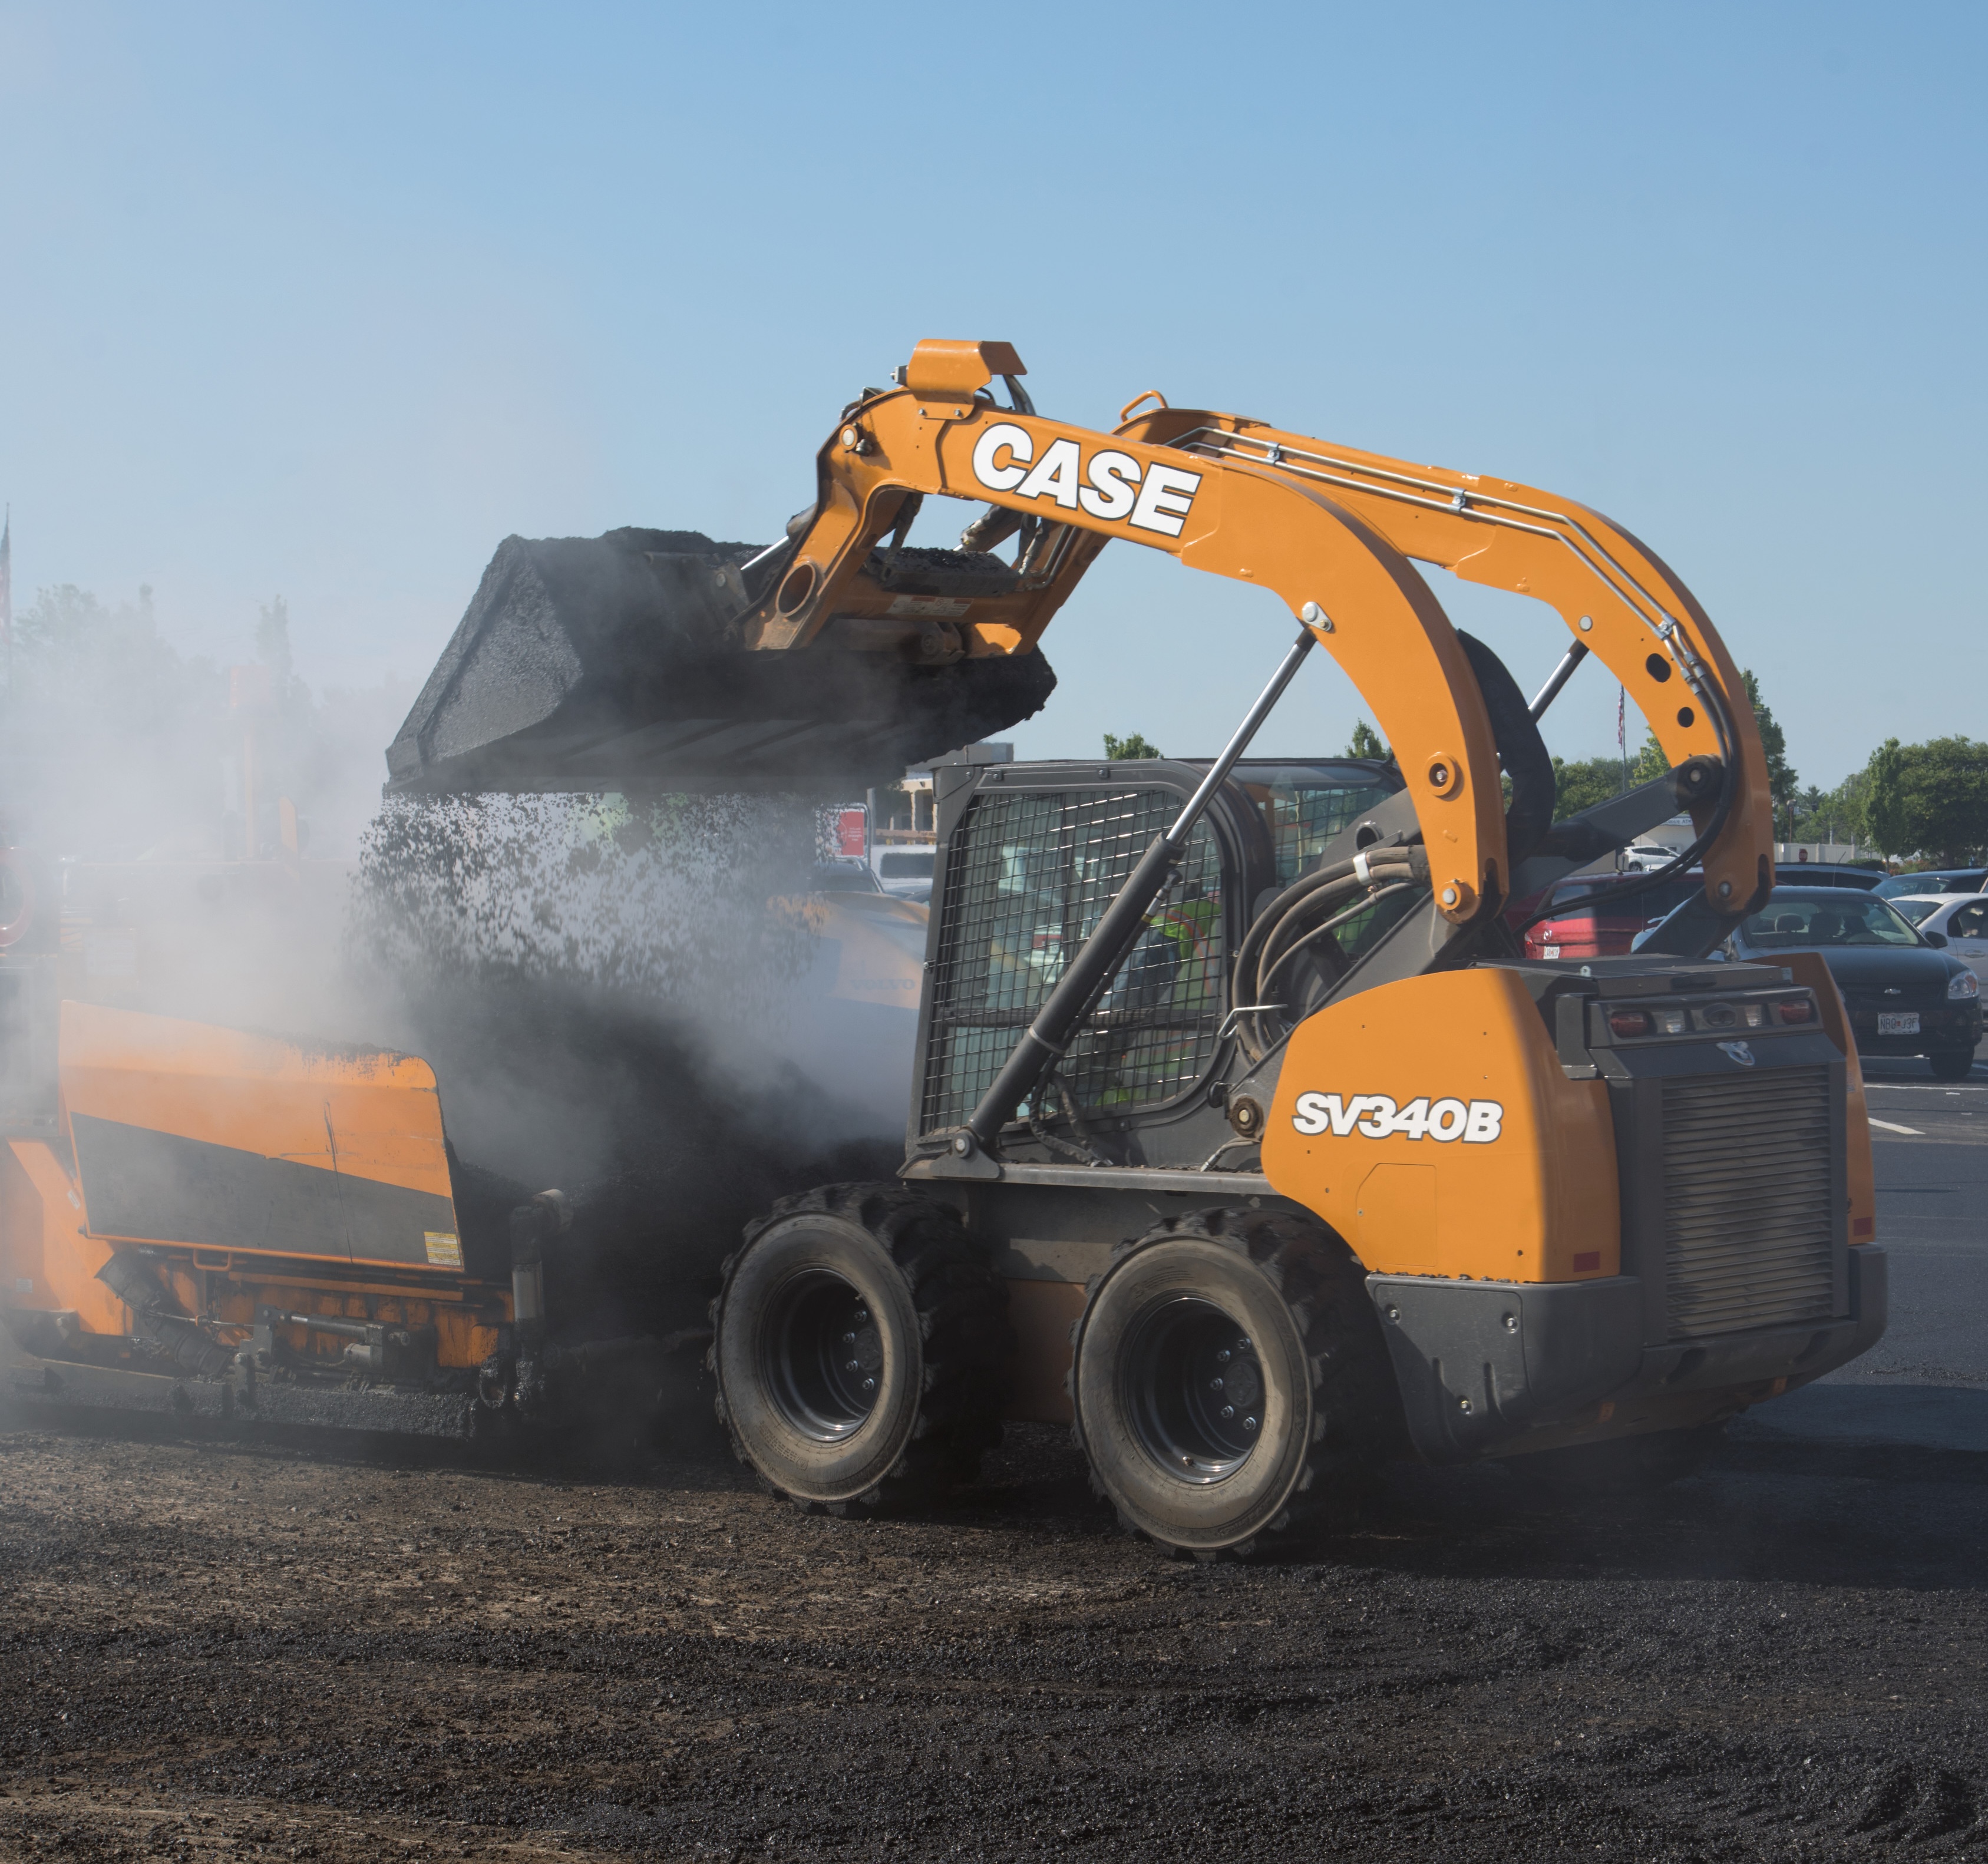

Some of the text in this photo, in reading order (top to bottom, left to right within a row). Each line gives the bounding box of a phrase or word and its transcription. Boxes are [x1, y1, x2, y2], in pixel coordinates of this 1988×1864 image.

[972, 422, 1203, 538] CASE
[849, 979, 916, 990] VOLVO
[1292, 1090, 1504, 1144] SV340B
